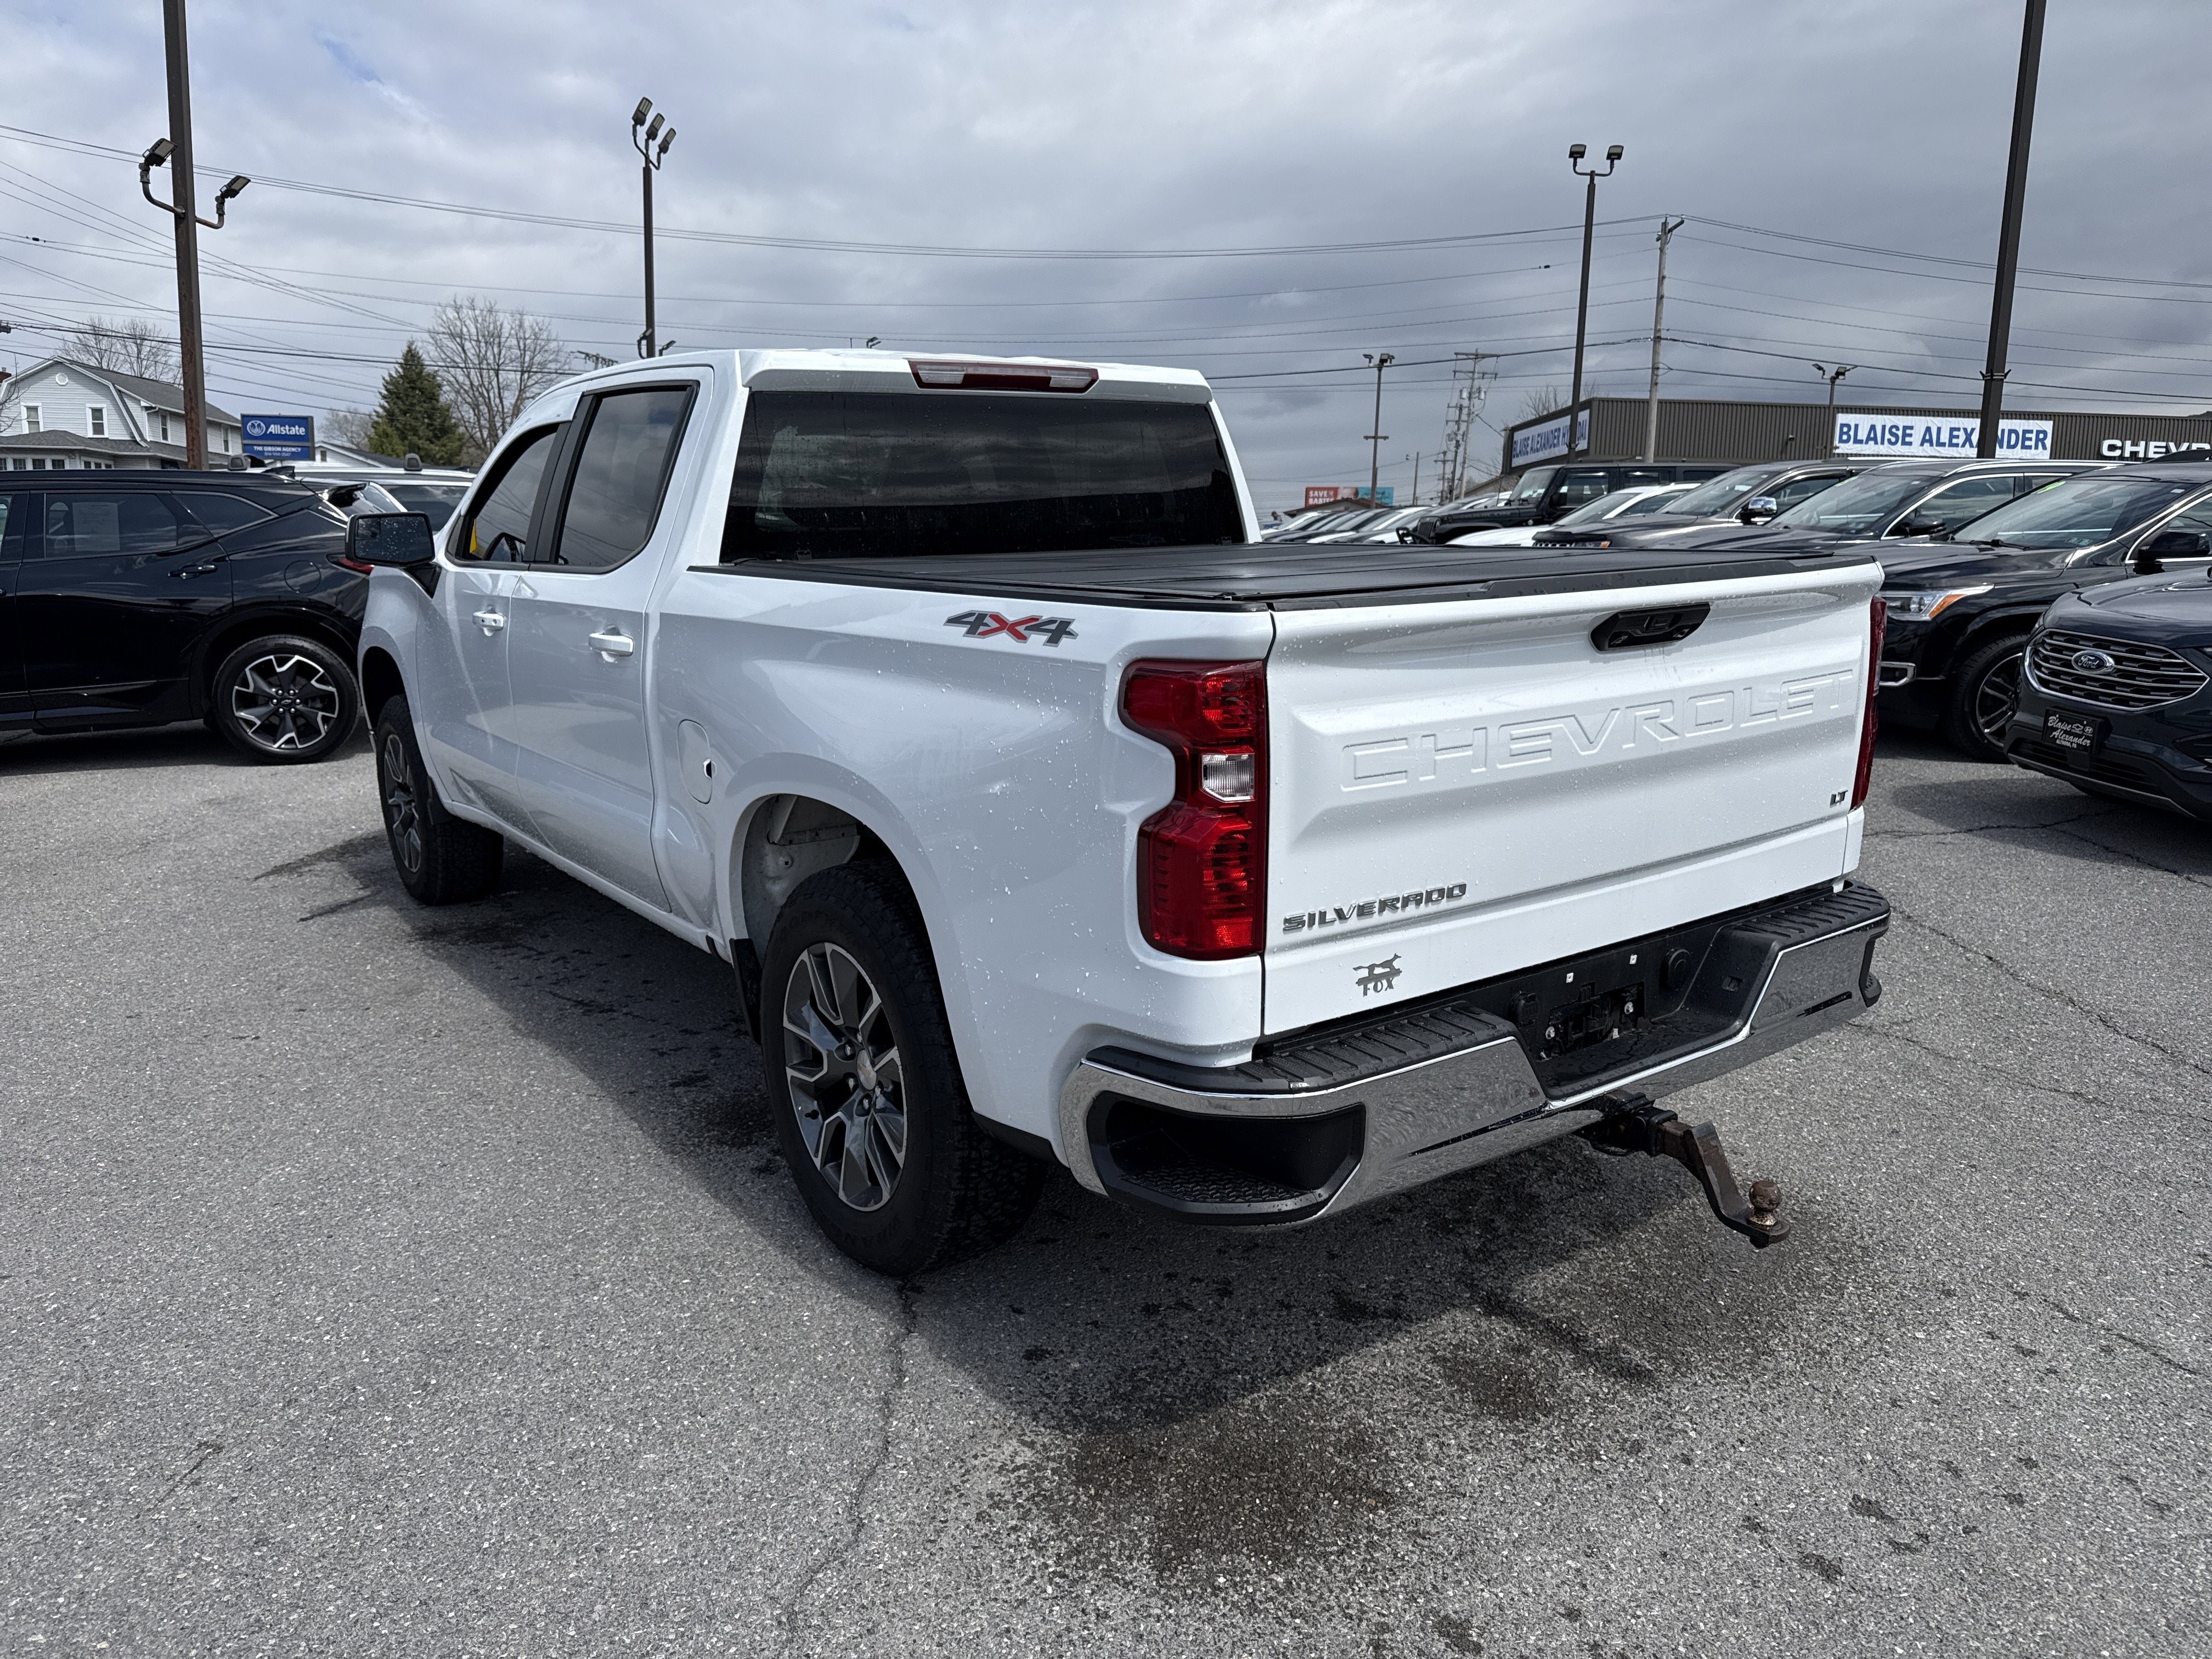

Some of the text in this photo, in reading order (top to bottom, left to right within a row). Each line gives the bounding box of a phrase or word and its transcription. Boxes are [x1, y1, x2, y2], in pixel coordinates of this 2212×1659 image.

[267, 424, 306, 436] Allstate
[1513, 419, 1587, 459] BLAISE ALEXANDER HYDAI
[1838, 423, 2048, 451] BLAISE ALEXNDER
[2078, 655, 2100, 669] Ford
[1341, 669, 1853, 792] CHEVROLET
[2047, 715, 2072, 731] Blaise
[2049, 729, 2091, 747] Alexander
[1830, 789, 1849, 805] LT
[1283, 881, 1467, 932] SILVERADO
[1363, 977, 1395, 997] FOX
